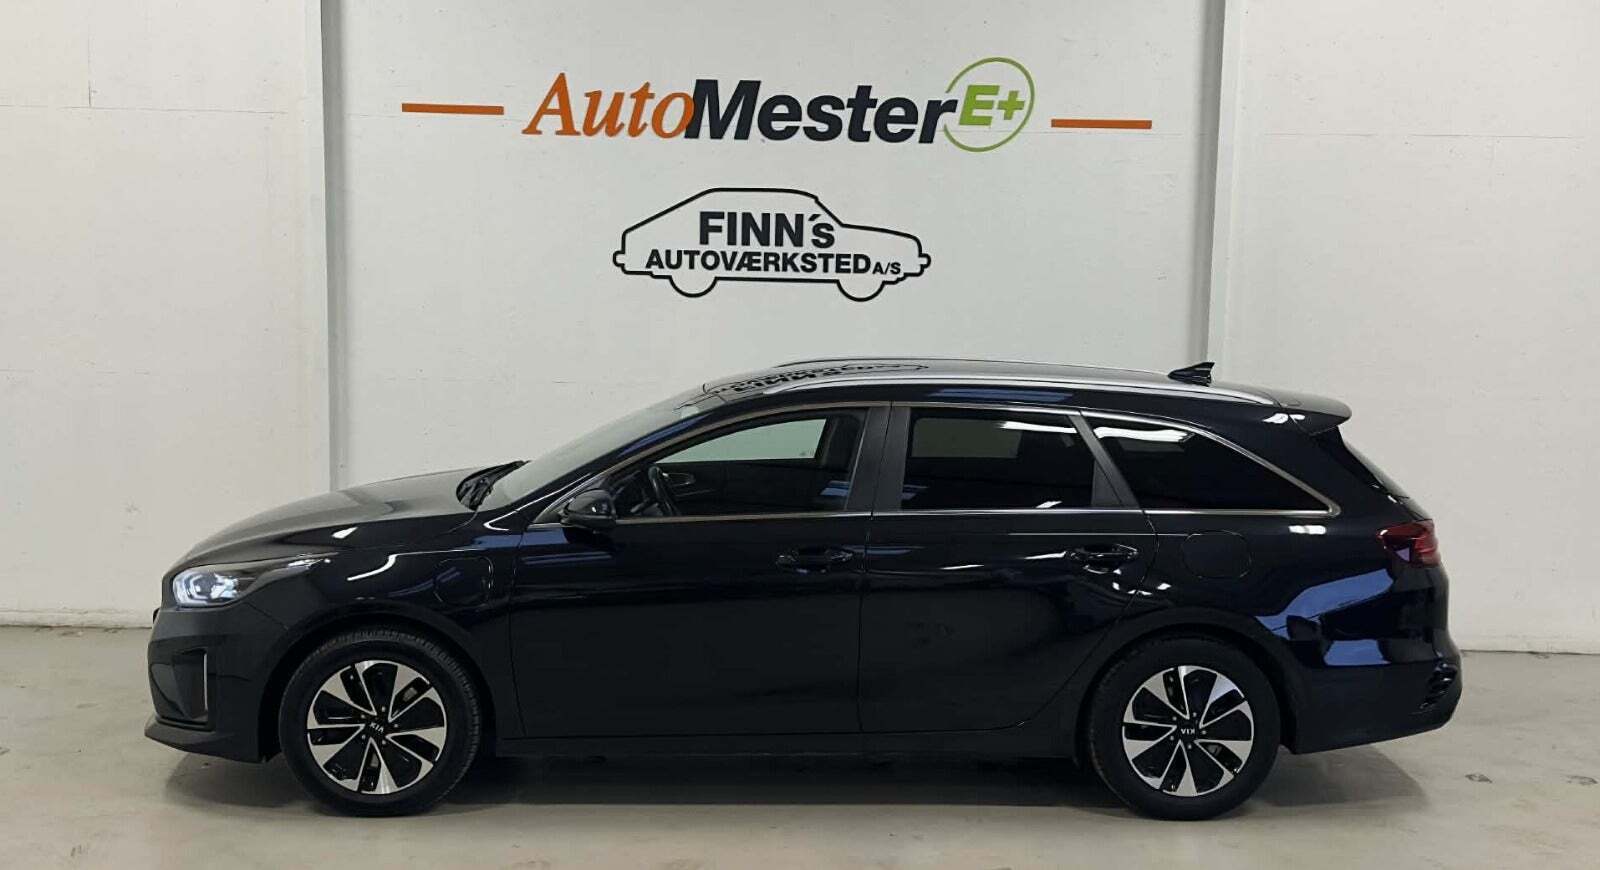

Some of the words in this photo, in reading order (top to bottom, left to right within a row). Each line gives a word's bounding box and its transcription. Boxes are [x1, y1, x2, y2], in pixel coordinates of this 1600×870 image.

[522, 73, 958, 144] AutoMester
[959, 84, 1025, 126] E+
[645, 249, 871, 274] AUTOVÆRKSTED
[872, 261, 902, 275] A/S
[369, 721, 385, 734] KIA
